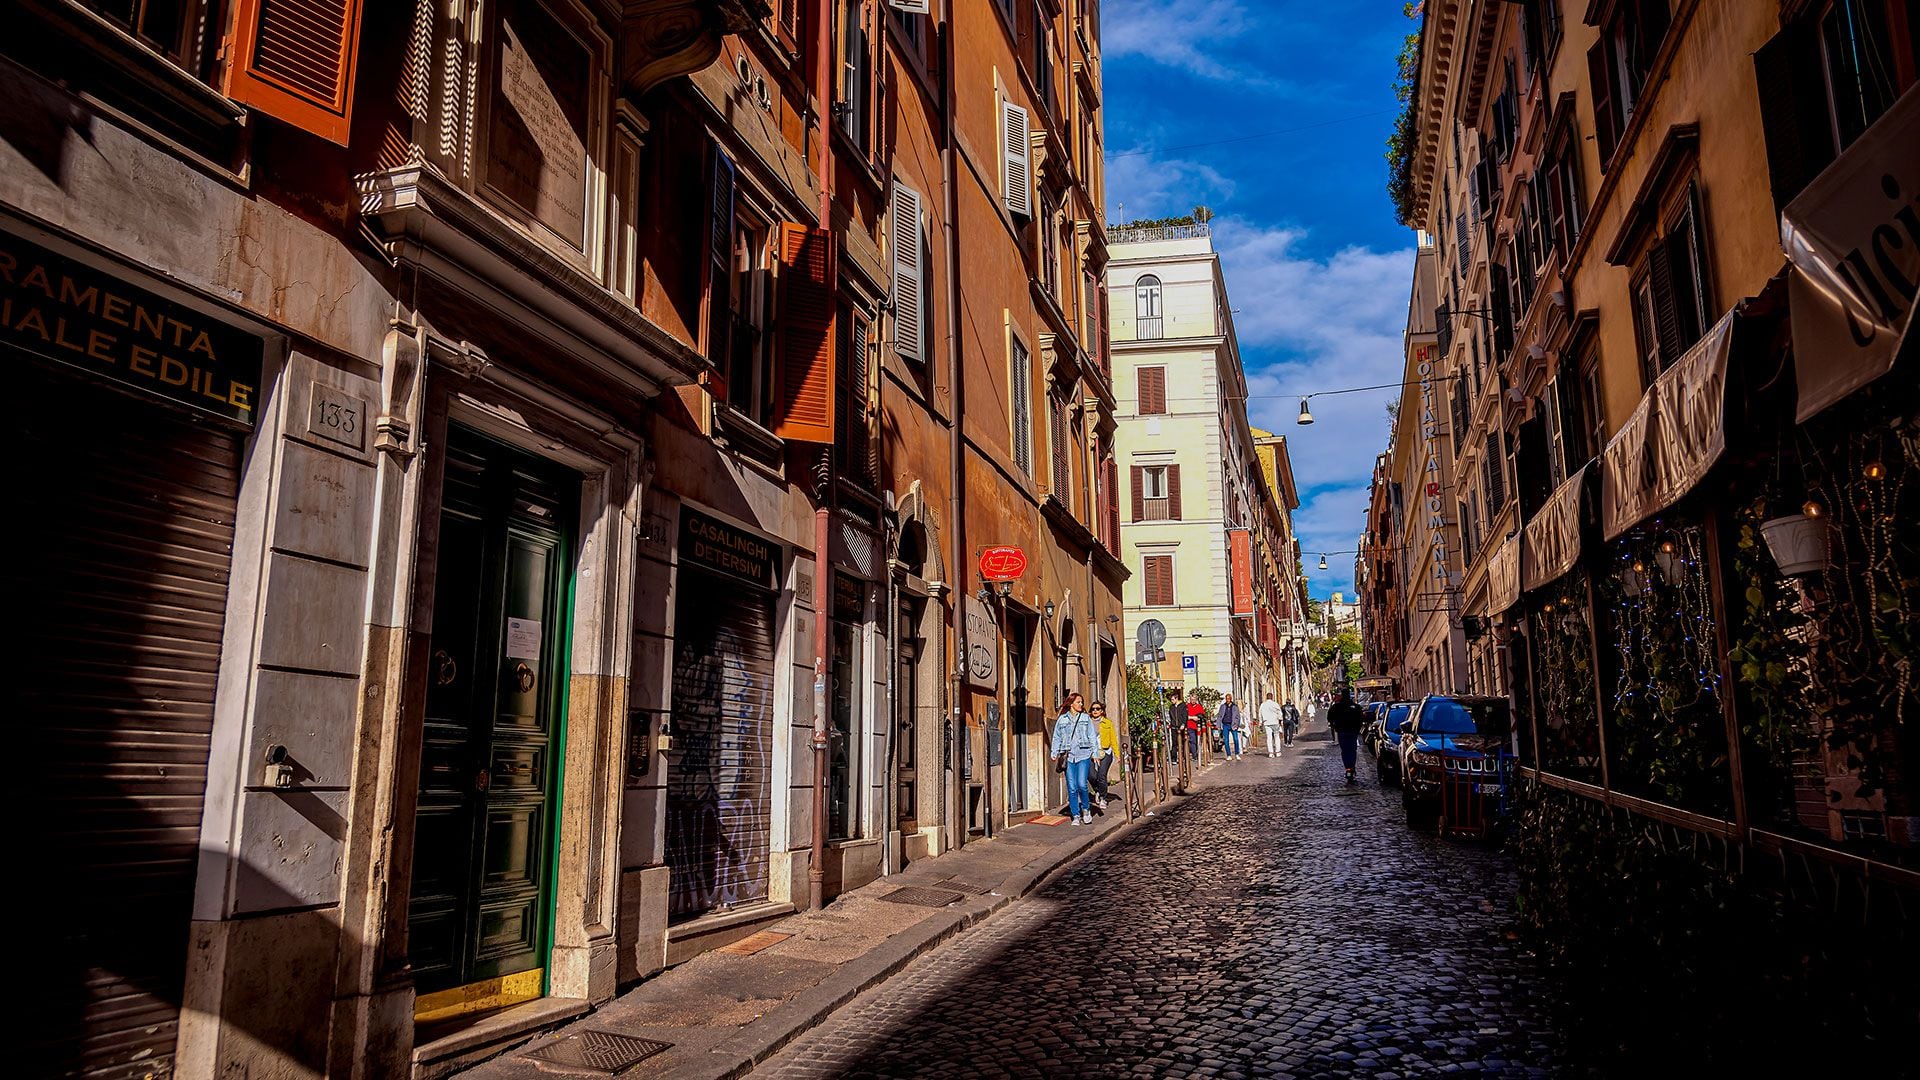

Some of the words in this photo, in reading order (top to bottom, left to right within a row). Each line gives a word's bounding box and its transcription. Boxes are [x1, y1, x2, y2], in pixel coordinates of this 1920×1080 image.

[129, 343, 254, 413] EDILE
[318, 399, 357, 433] 133
[1416, 346, 1437, 472] HOSTARIA
[1427, 482, 1447, 579] ROMANA
[689, 516, 768, 562] CASALINGHI
[695, 545, 761, 579] DETERSIVI
[1184, 657, 1192, 667] P
